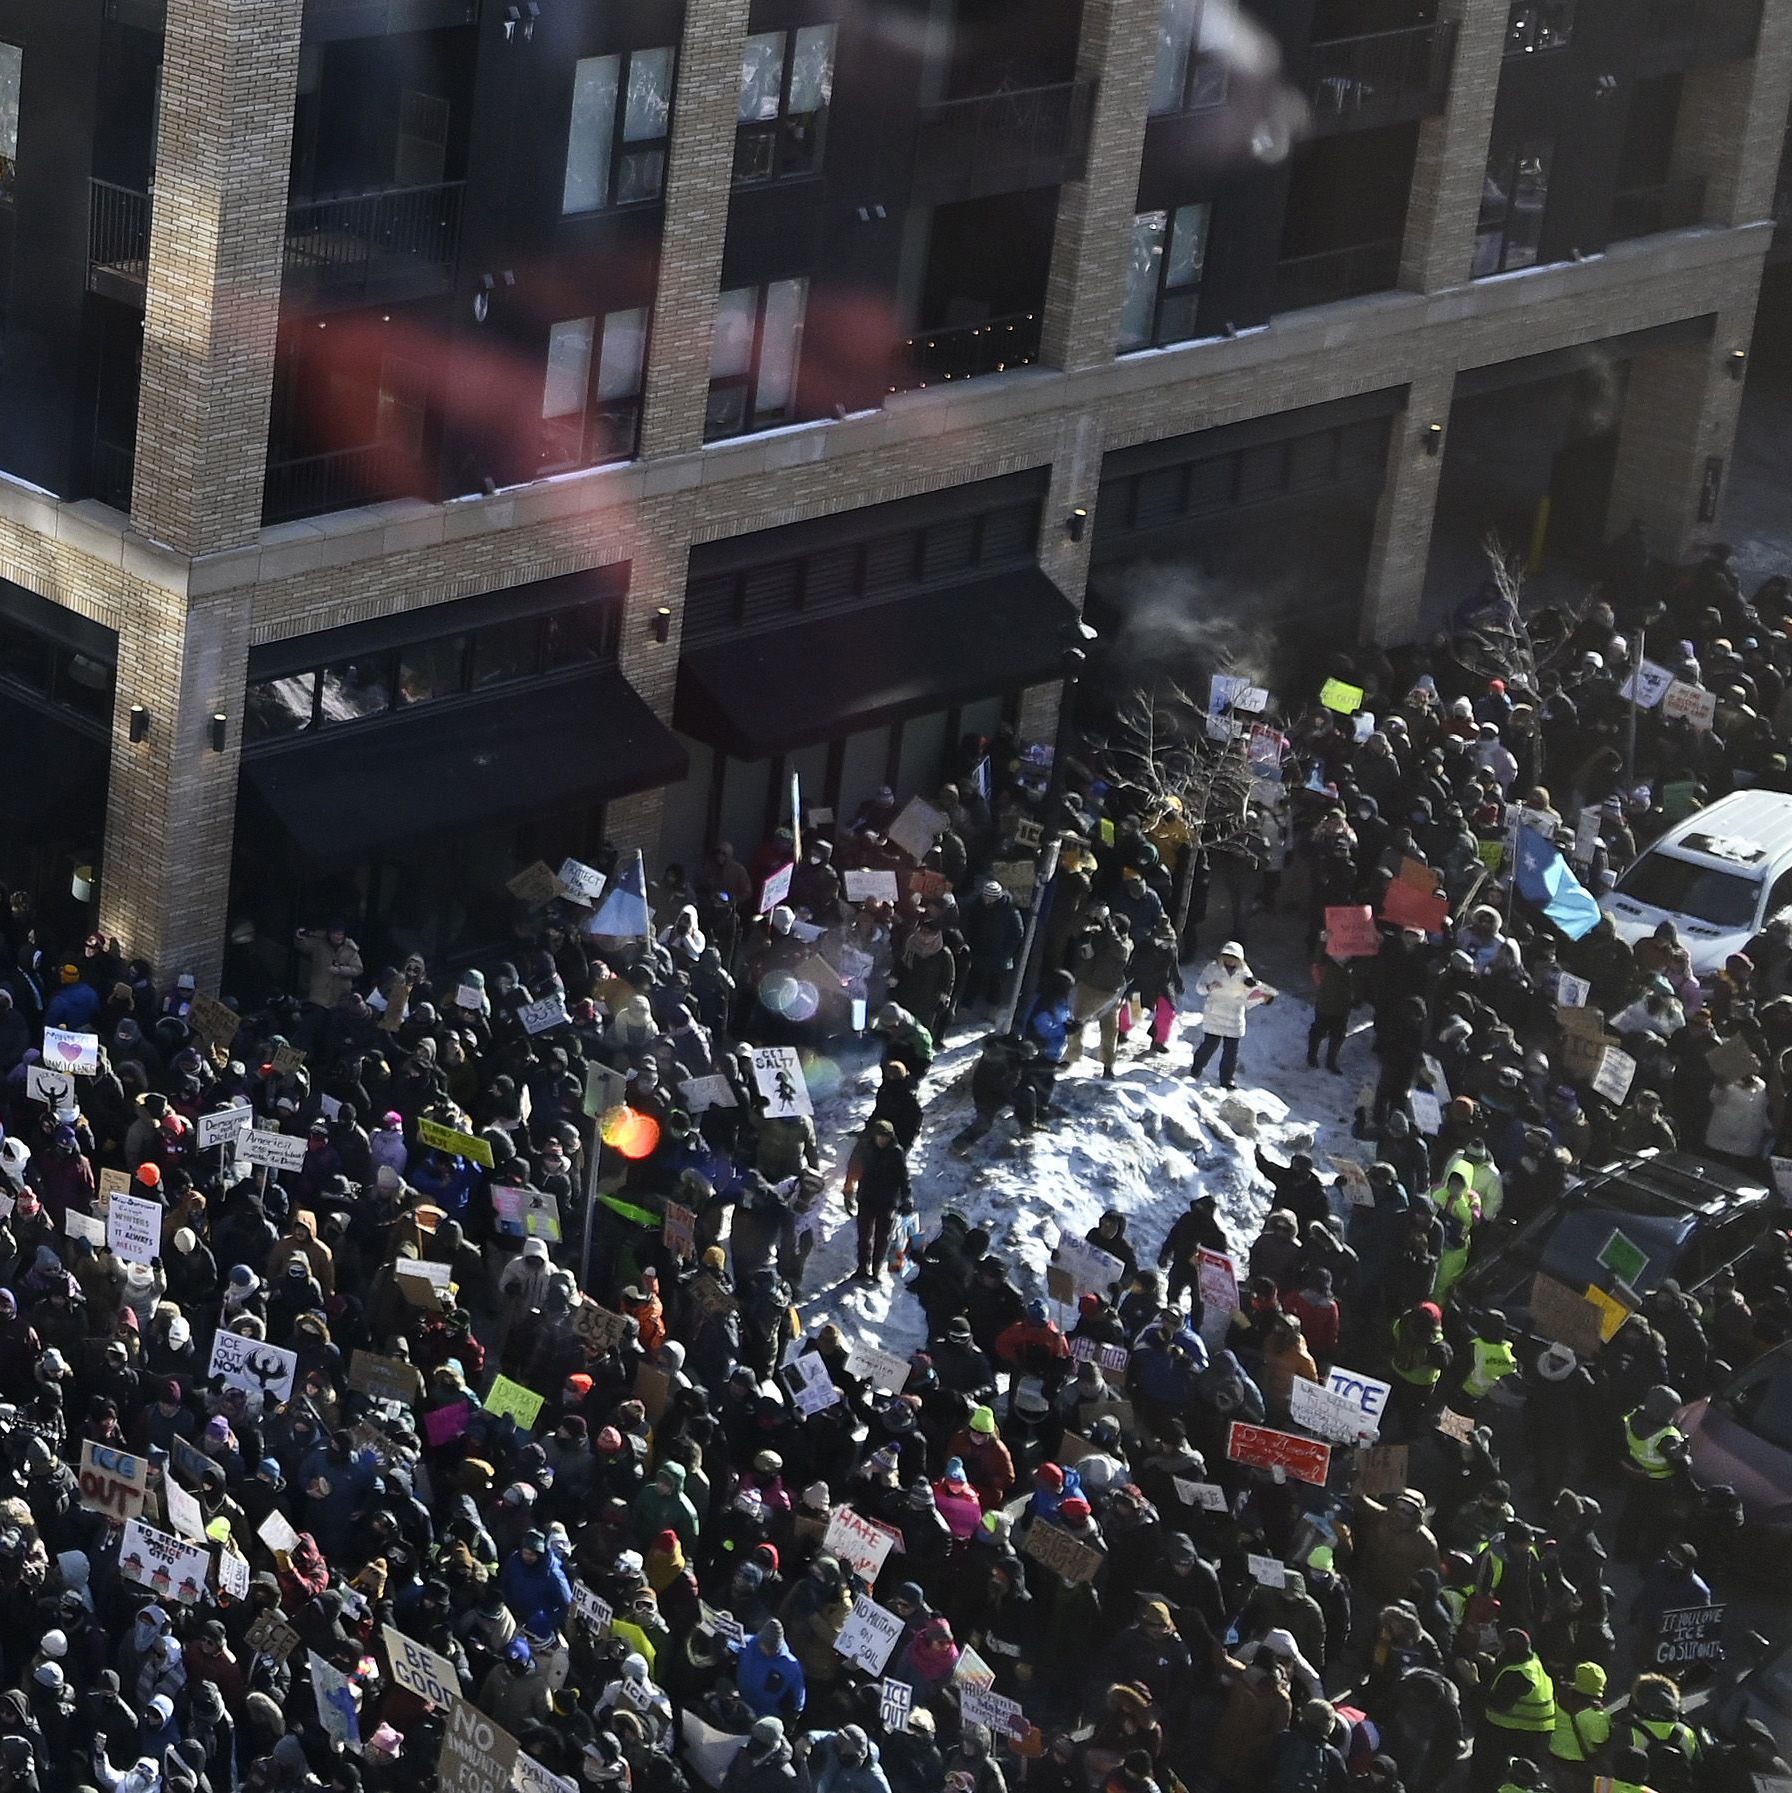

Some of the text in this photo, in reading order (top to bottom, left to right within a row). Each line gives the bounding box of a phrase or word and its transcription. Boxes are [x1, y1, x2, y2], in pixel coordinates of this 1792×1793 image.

[755, 1056, 793, 1070] SALTY
[761, 1048, 784, 1058] GET
[217, 1349, 242, 1363] OUT
[219, 1337, 241, 1351] ICE
[213, 1360, 242, 1376] NOW
[1330, 1374, 1386, 1416] ICE
[91, 1446, 136, 1478] ICE
[79, 1471, 142, 1516] OUT
[137, 1525, 200, 1559] NO SECRET
[838, 1508, 881, 1549] HATE
[403, 1641, 437, 1673] BE
[883, 1679, 910, 1707] ICE
[454, 1704, 495, 1752] NO
[882, 1702, 908, 1729] OUT
